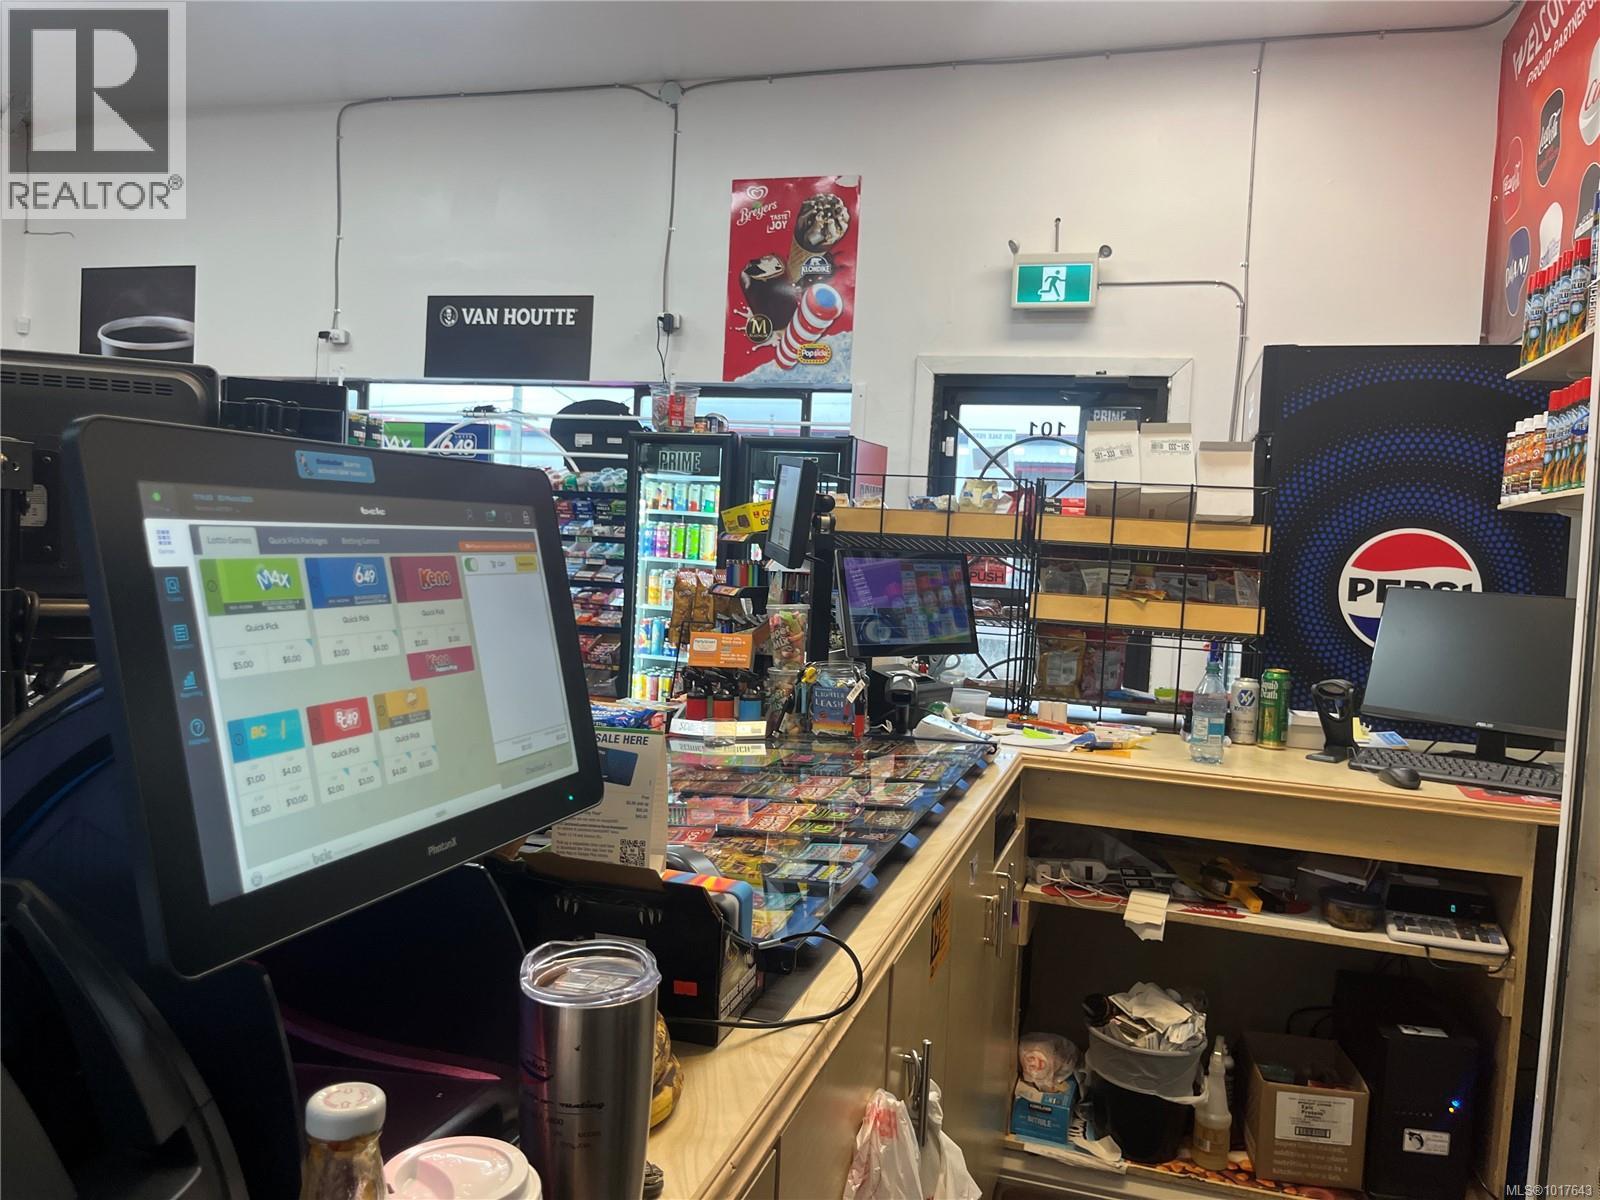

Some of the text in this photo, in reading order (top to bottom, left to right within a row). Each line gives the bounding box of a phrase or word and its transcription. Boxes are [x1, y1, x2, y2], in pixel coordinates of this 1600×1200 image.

[1526, 48, 1552, 87] PROUD
[1552, 2, 1588, 57] PARTNER
[737, 201, 777, 225] Breyers
[769, 220, 788, 230] JOY
[461, 308, 577, 325] VAN HOUTTE
[751, 319, 766, 334] M
[1092, 410, 1127, 422] PRIME
[659, 451, 701, 472] PRIME
[256, 568, 291, 591] MAX
[418, 568, 451, 590] Keno
[970, 571, 1005, 584] PUSH
[342, 615, 358, 624] Quick
[245, 622, 279, 633] Quick Pick
[233, 660, 254, 670] $5.00
[815, 698, 844, 708] LEASH
[596, 733, 649, 746] SALE HERE
[331, 750, 348, 759] Quick
